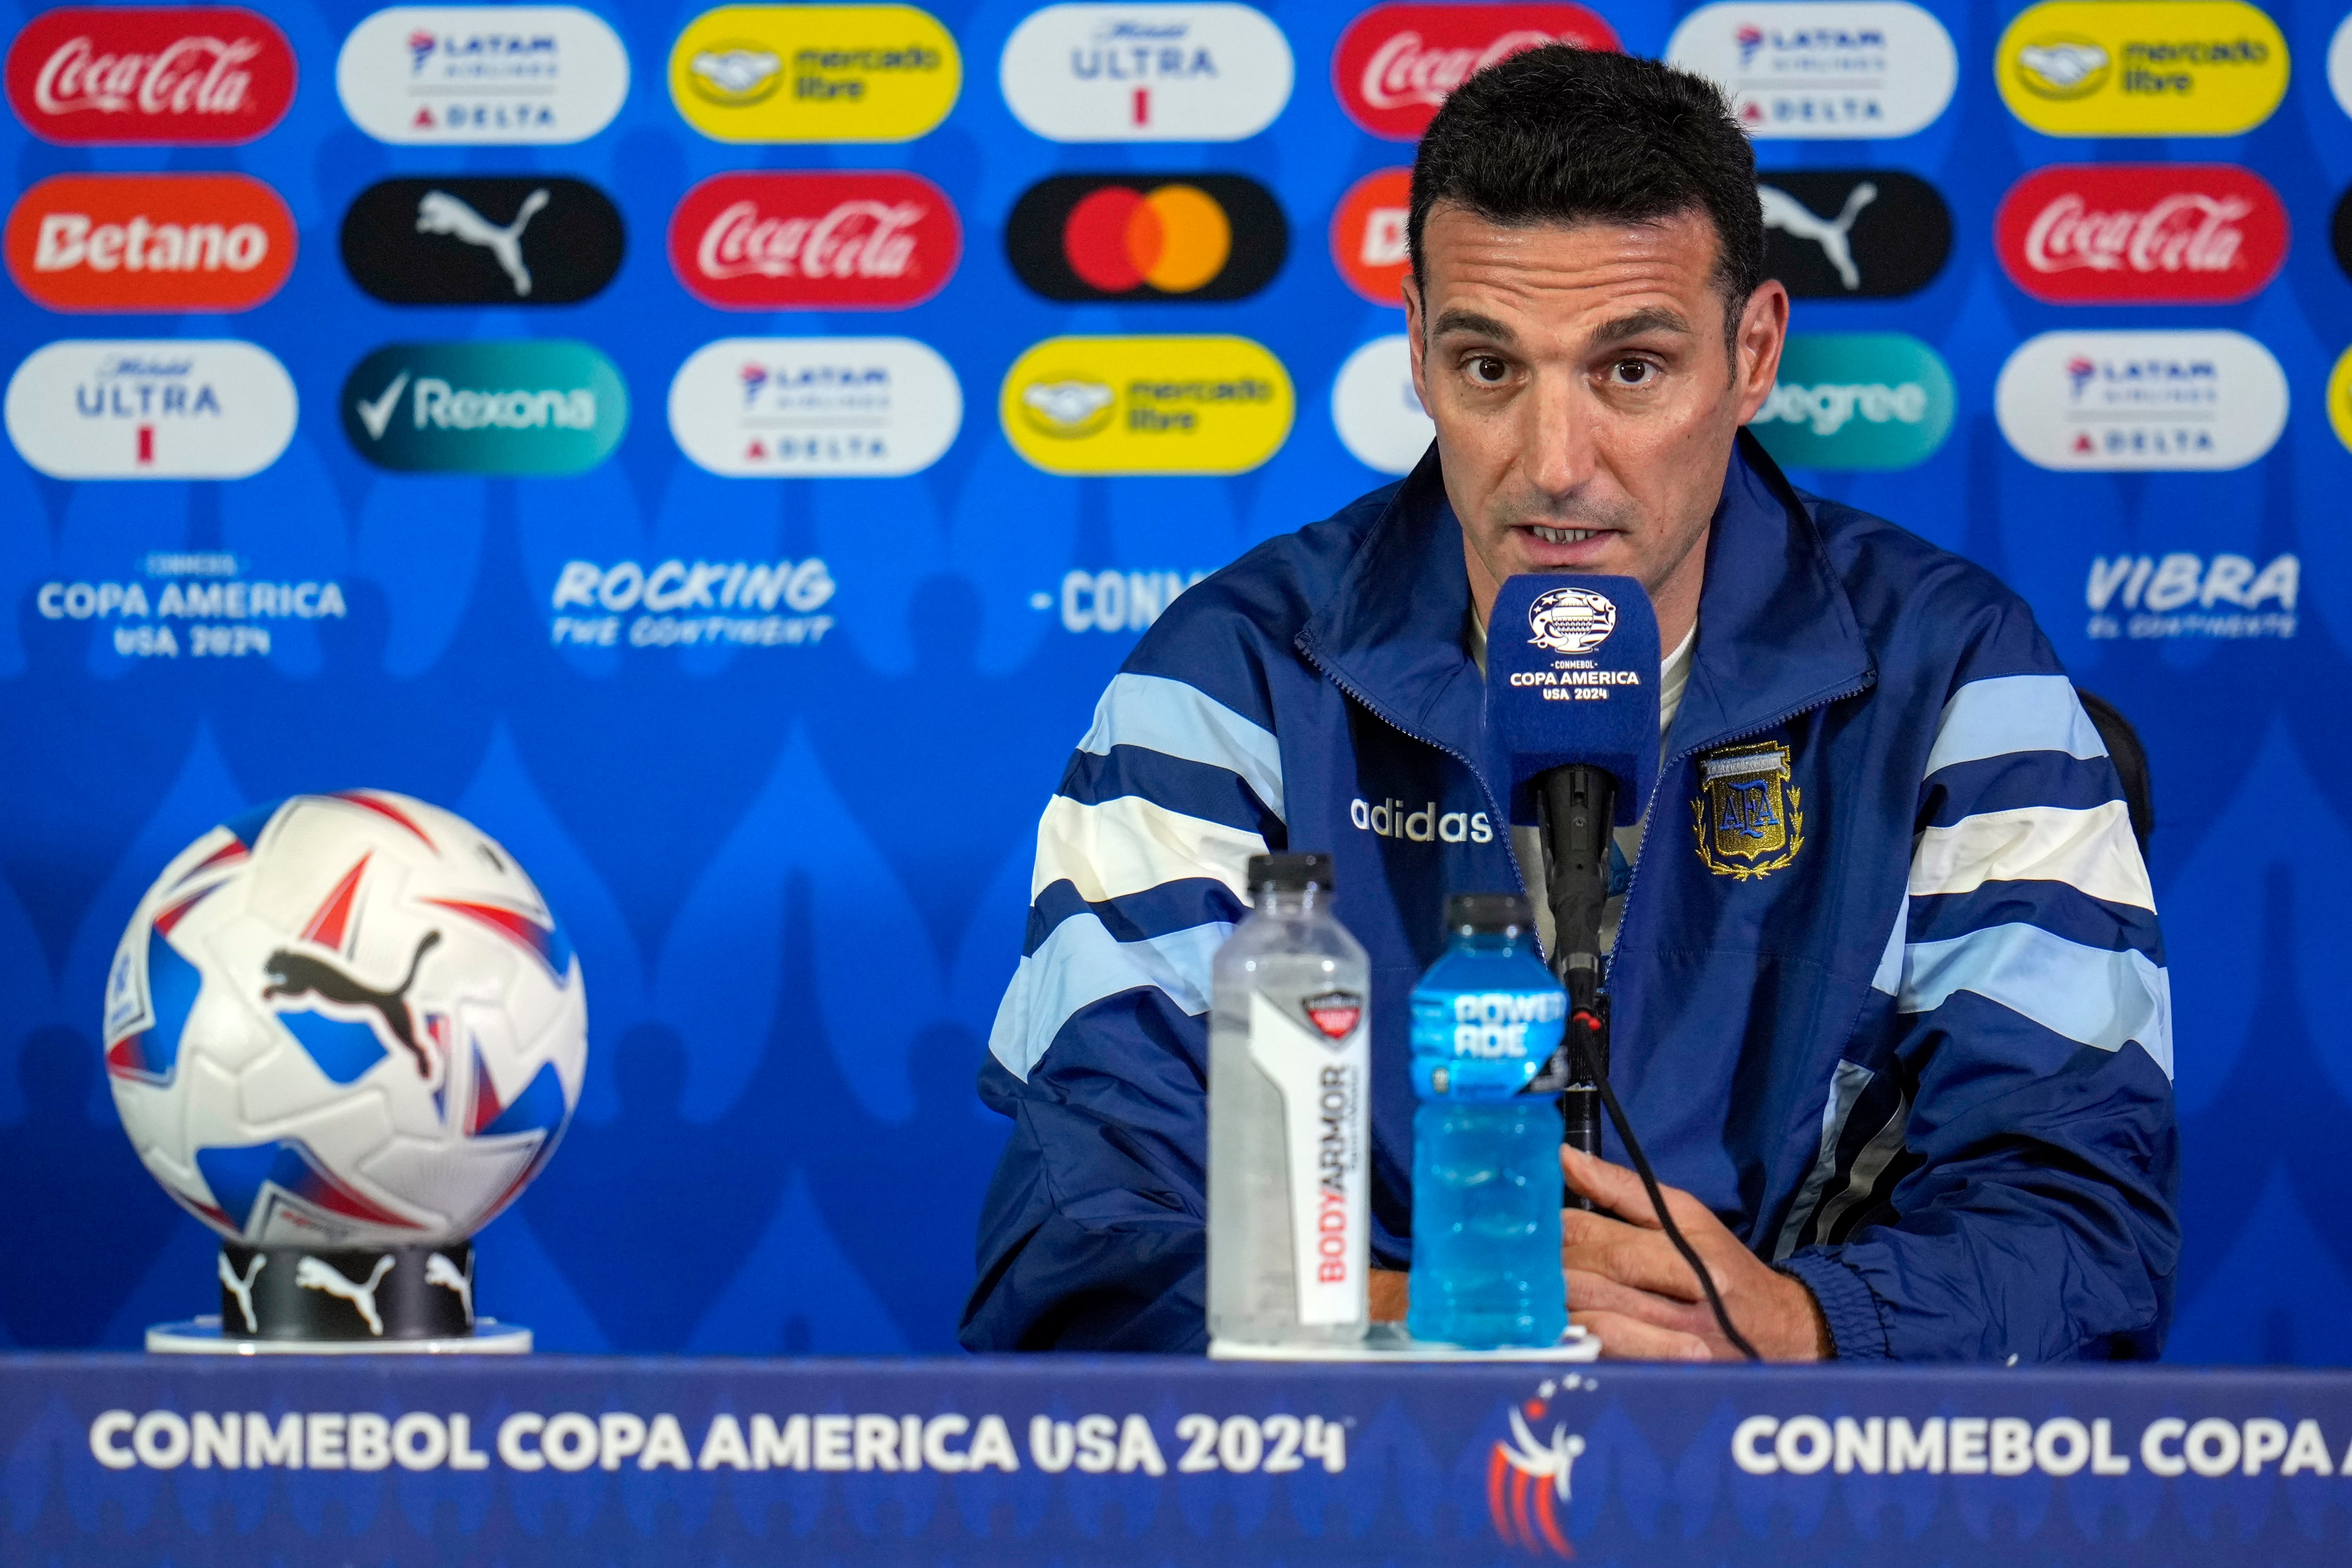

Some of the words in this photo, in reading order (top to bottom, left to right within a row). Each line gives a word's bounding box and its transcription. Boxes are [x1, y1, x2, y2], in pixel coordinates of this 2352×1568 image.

[444, 36, 556, 55] LATAM
[1772, 30, 1883, 49] LATAM
[2124, 40, 2268, 63] mercado
[795, 46, 939, 70] mercado
[1072, 47, 1216, 79] ULTRA
[795, 74, 864, 100] libre
[2122, 67, 2192, 93] libre
[446, 105, 554, 127] DELTA
[1773, 99, 1881, 121] DELTA
[34, 214, 268, 271] Betano
[777, 368, 888, 387] LATAM
[2104, 362, 2216, 381] LATAM
[76, 384, 220, 417] ULTRA
[1128, 379, 1271, 402] mercado
[414, 379, 596, 430] Rexona
[1128, 406, 1196, 431] libre
[778, 437, 886, 459] DELTA
[2105, 430, 2213, 453] DELTA
[552, 558, 835, 612] ROCKING
[2086, 553, 2300, 611] VIBRA
[38, 583, 150, 618] COPA
[158, 582, 346, 618] AMERICA
[113, 626, 178, 657] USA
[190, 625, 271, 656] 2024
[1510, 672, 1558, 687] COPA
[1559, 670, 1640, 685] AMERICA
[1542, 687, 1570, 700] USA
[1574, 687, 1608, 700] 2024
[1351, 797, 1494, 843] adidas
[1319, 1064, 1347, 1283] BODYARMOR
[89, 1410, 489, 1471] CONMEBOL
[497, 1412, 692, 1472] COPA
[698, 1414, 1019, 1473] AMERICA
[1029, 1414, 1166, 1476] USA
[1176, 1414, 1346, 1473] 2024
[1732, 1415, 2130, 1476] CONMEBOL
[2140, 1418, 2333, 1477] COPA
